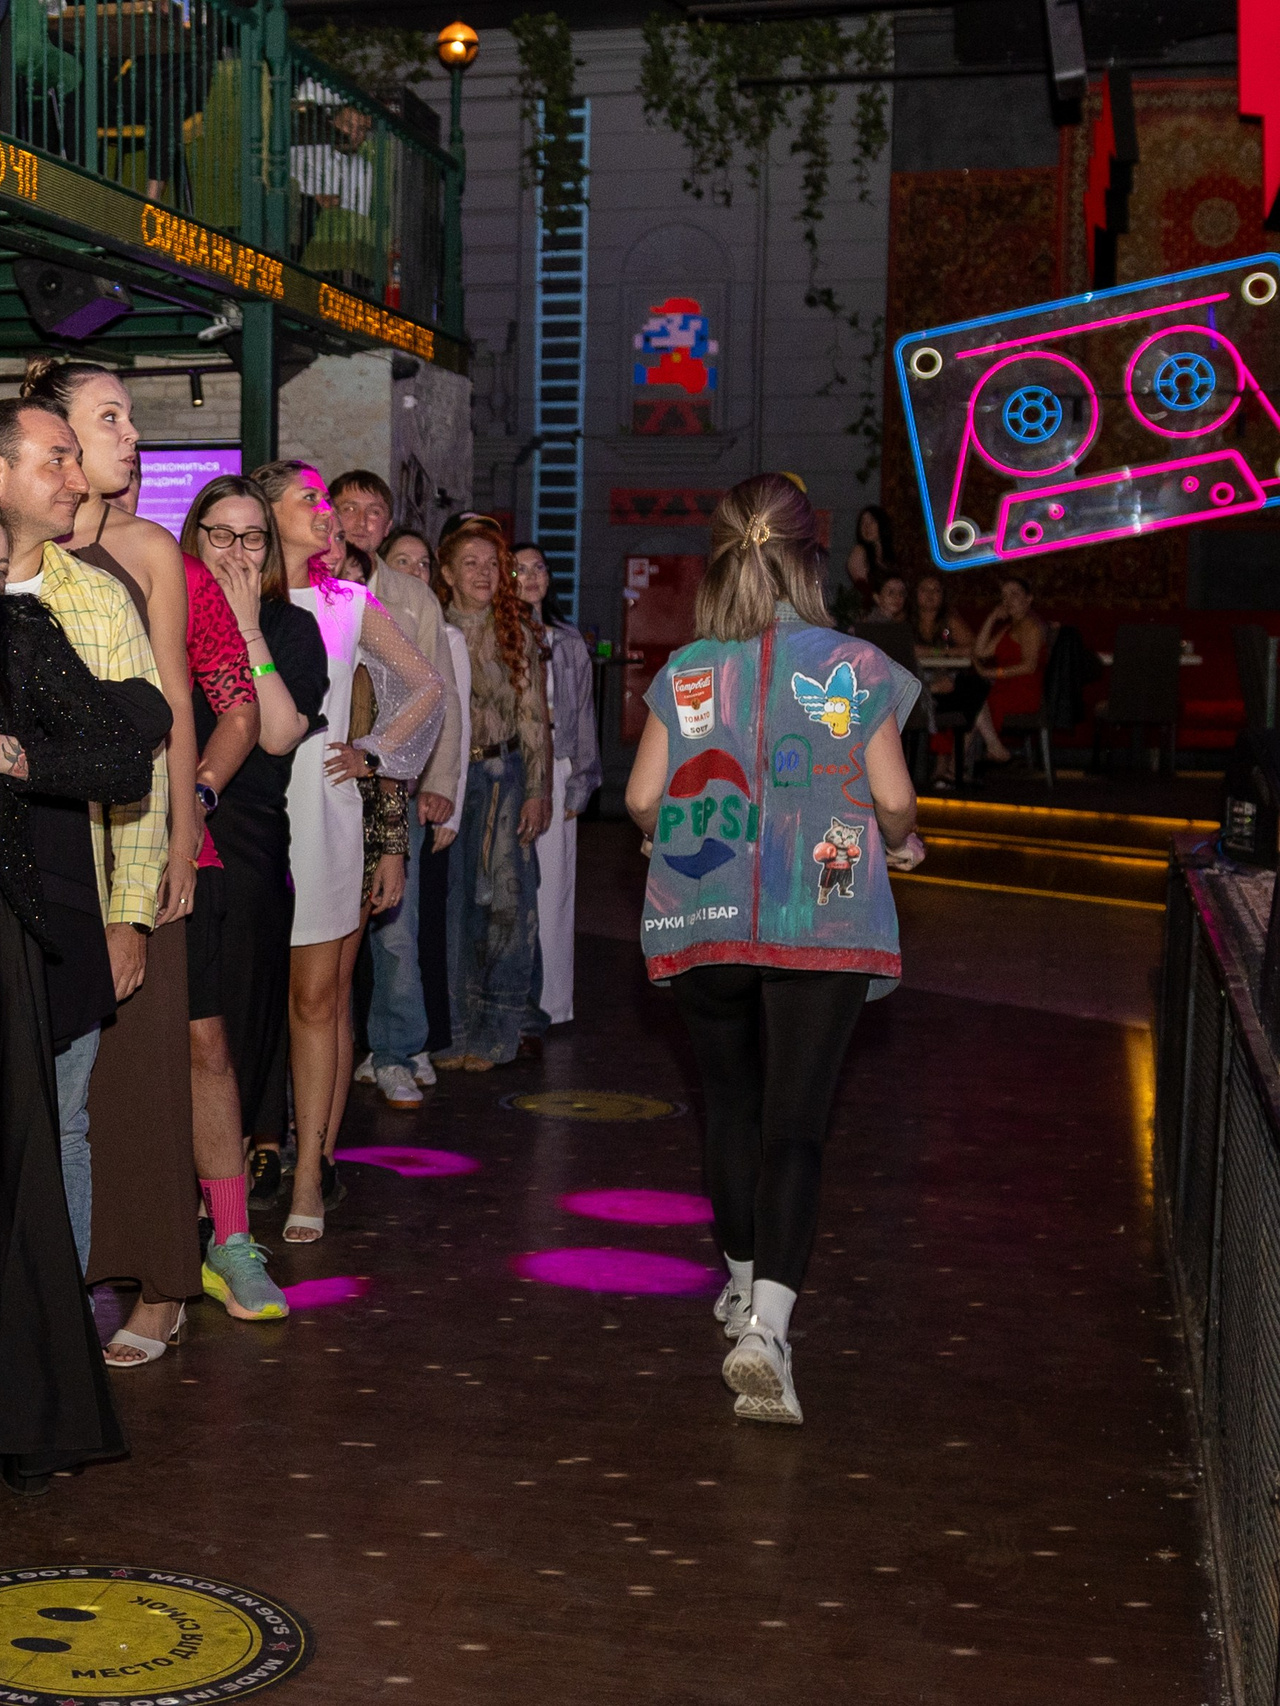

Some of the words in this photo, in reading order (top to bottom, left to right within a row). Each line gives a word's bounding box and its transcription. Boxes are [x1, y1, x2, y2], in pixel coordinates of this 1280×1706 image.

[141, 203, 210, 267] СКИДКА
[684, 711, 710, 723] TOMATO
[658, 794, 760, 843] PEPSI
[644, 916, 685, 932] РУКИ
[708, 906, 739, 920] БАР
[17, 1568, 89, 1579] 90'S
[127, 1596, 202, 1631] СУМОК
[148, 1573, 234, 1597] MADE
[231, 1594, 260, 1609] IN
[255, 1607, 290, 1635] 90'S
[168, 1633, 204, 1660] ДЛЯ
[71, 1657, 174, 1679] МЕСТО
[220, 1658, 284, 1693] MADE
[183, 1688, 220, 1702] IN
